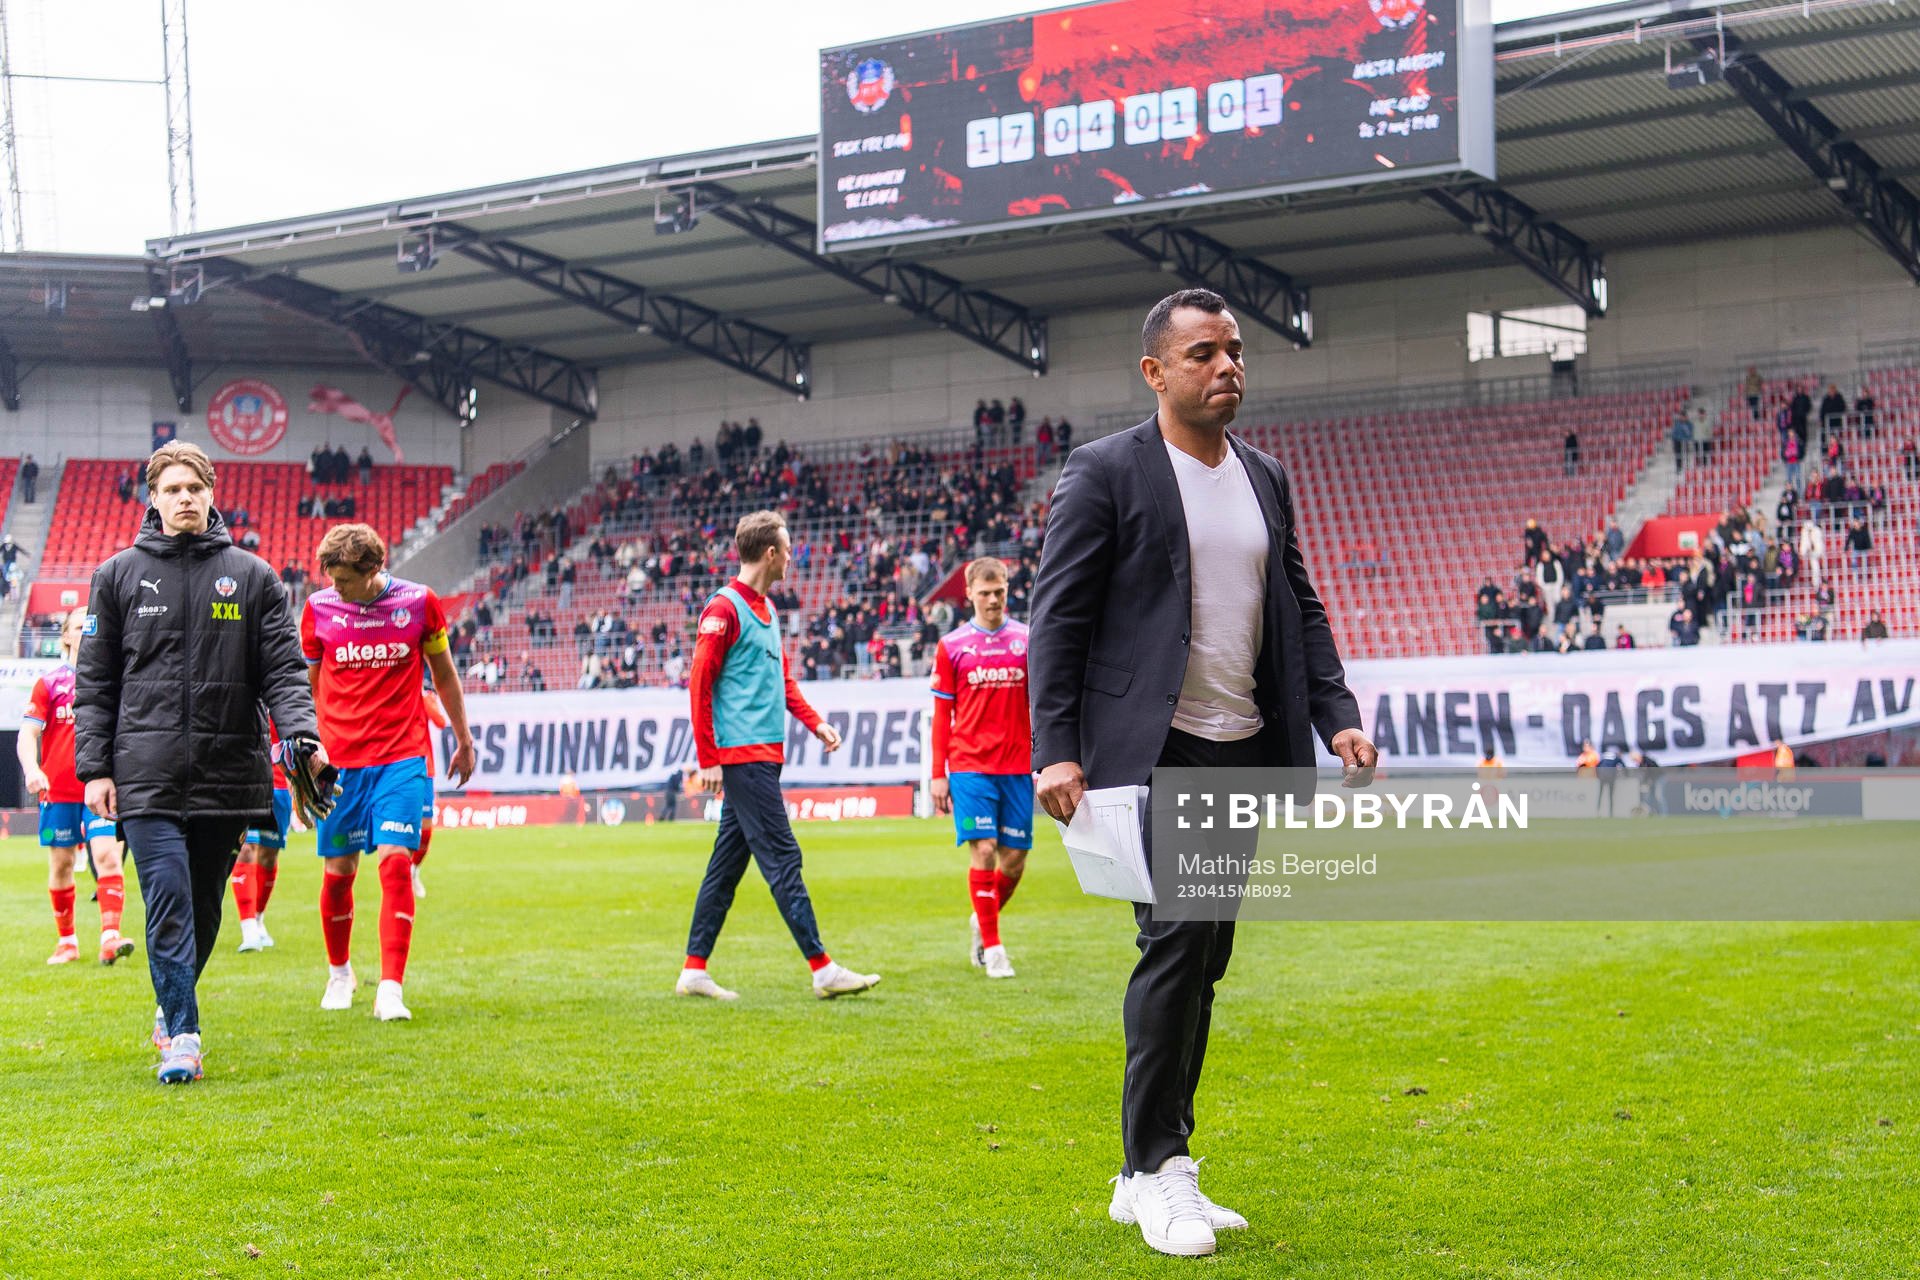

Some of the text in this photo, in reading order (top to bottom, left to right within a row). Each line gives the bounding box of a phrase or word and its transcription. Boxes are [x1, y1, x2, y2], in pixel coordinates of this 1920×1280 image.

[211, 602, 242, 621] XXL
[335, 641, 387, 663] akea
[967, 666, 1009, 685] akea
[1562, 685, 1705, 757] DAGS
[1728, 682, 1826, 747] ATT
[1848, 678, 1915, 726] AV
[515, 717, 658, 776] MINNAS
[1683, 780, 1815, 812] kondektor
